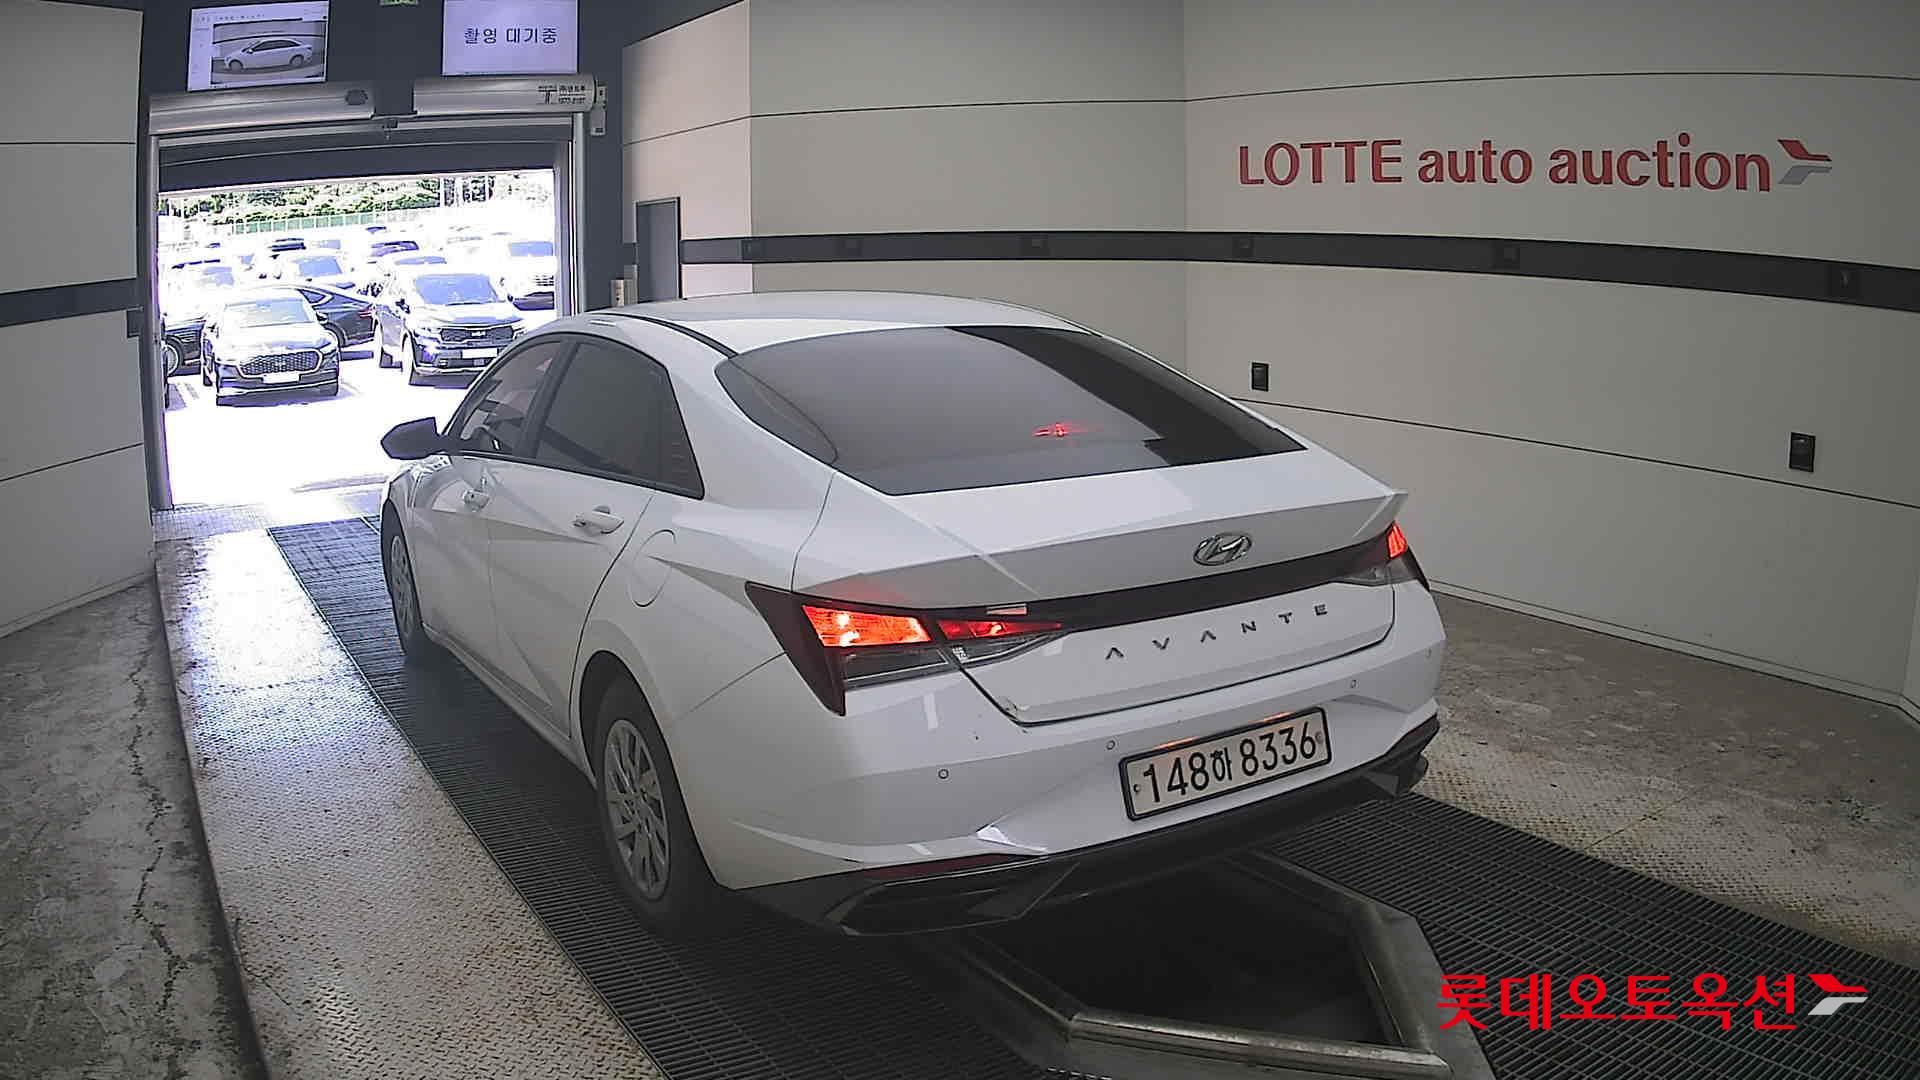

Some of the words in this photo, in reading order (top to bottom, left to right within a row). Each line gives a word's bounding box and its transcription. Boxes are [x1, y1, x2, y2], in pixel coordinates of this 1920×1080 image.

[464, 27, 497, 45] 촬영
[506, 27, 558, 45] 대기중
[1239, 139, 1402, 186] LOTTE
[1417, 139, 1533, 184] auto
[1549, 132, 1771, 192] auction
[1104, 603, 1328, 660] AVANTE
[1143, 746, 1233, 803] 148하
[1239, 721, 1317, 777] 8336
